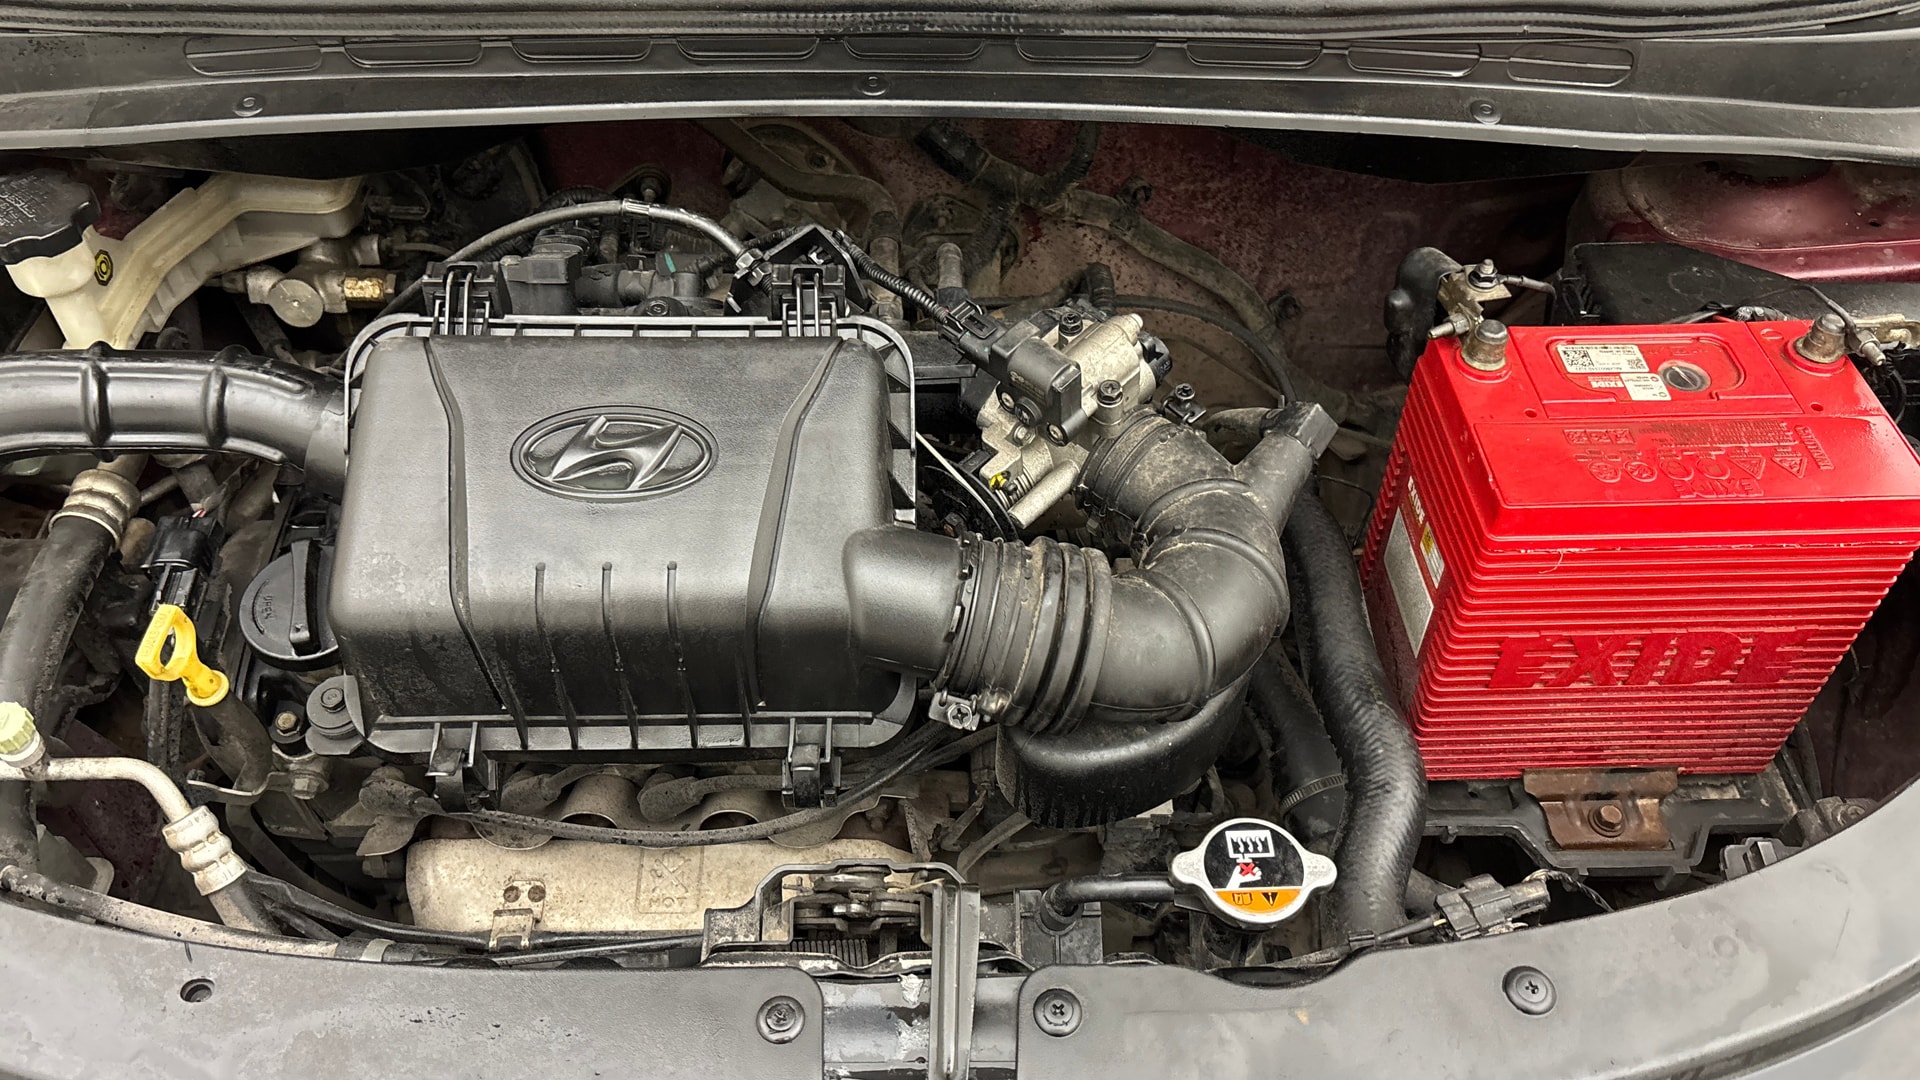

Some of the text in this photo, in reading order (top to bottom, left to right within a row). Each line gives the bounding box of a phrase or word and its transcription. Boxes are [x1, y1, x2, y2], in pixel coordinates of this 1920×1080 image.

[1590, 380, 1624, 388] EXIDE
[1408, 475, 1425, 524] EXIDE
[1674, 478, 1764, 498] EXIDE
[1489, 629, 1814, 688] EXIDE
